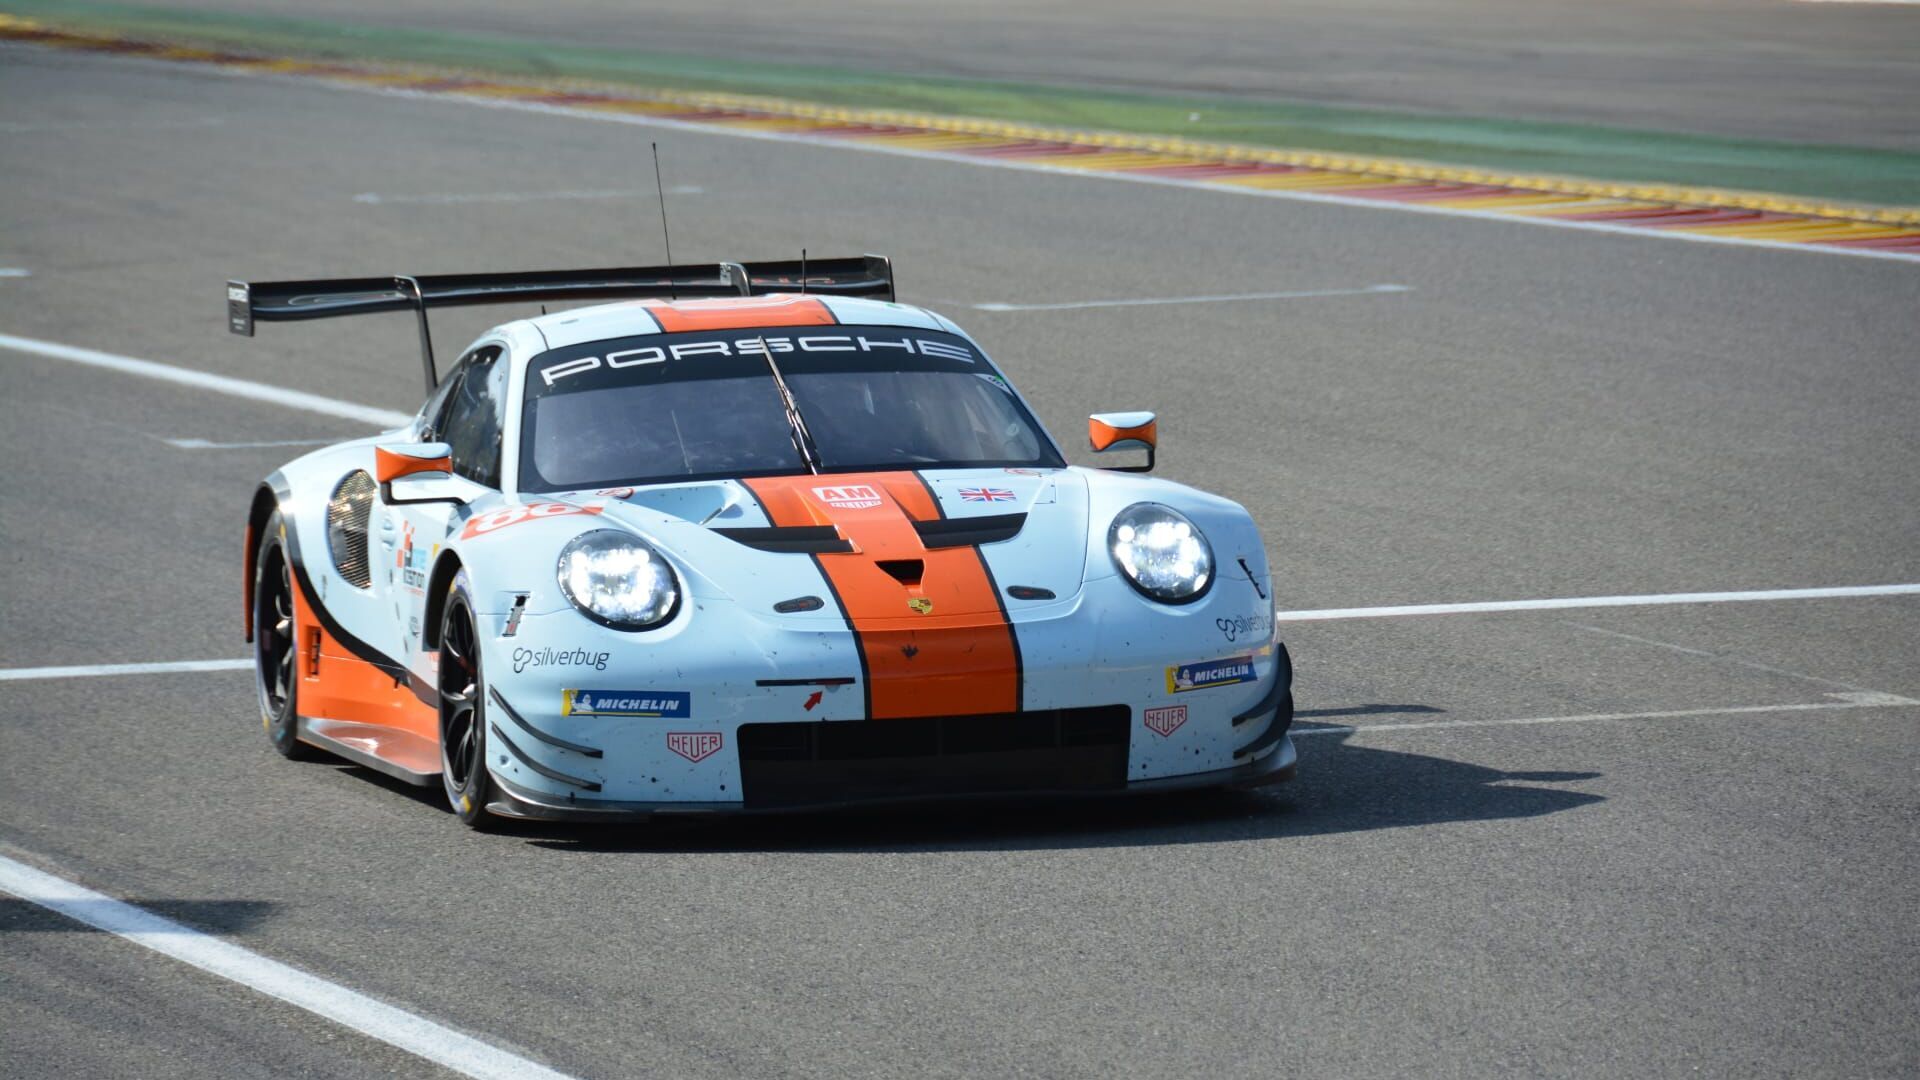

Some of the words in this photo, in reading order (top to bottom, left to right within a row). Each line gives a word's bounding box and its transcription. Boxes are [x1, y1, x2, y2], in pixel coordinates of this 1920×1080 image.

[541, 336, 975, 386] PORSCHE
[822, 487, 876, 500] AM
[533, 647, 610, 671] silverbug
[1194, 664, 1249, 683] MICHELIN
[596, 698, 680, 711] MICHELIN
[1147, 708, 1185, 734] HEUER
[671, 736, 718, 758] HEUER
